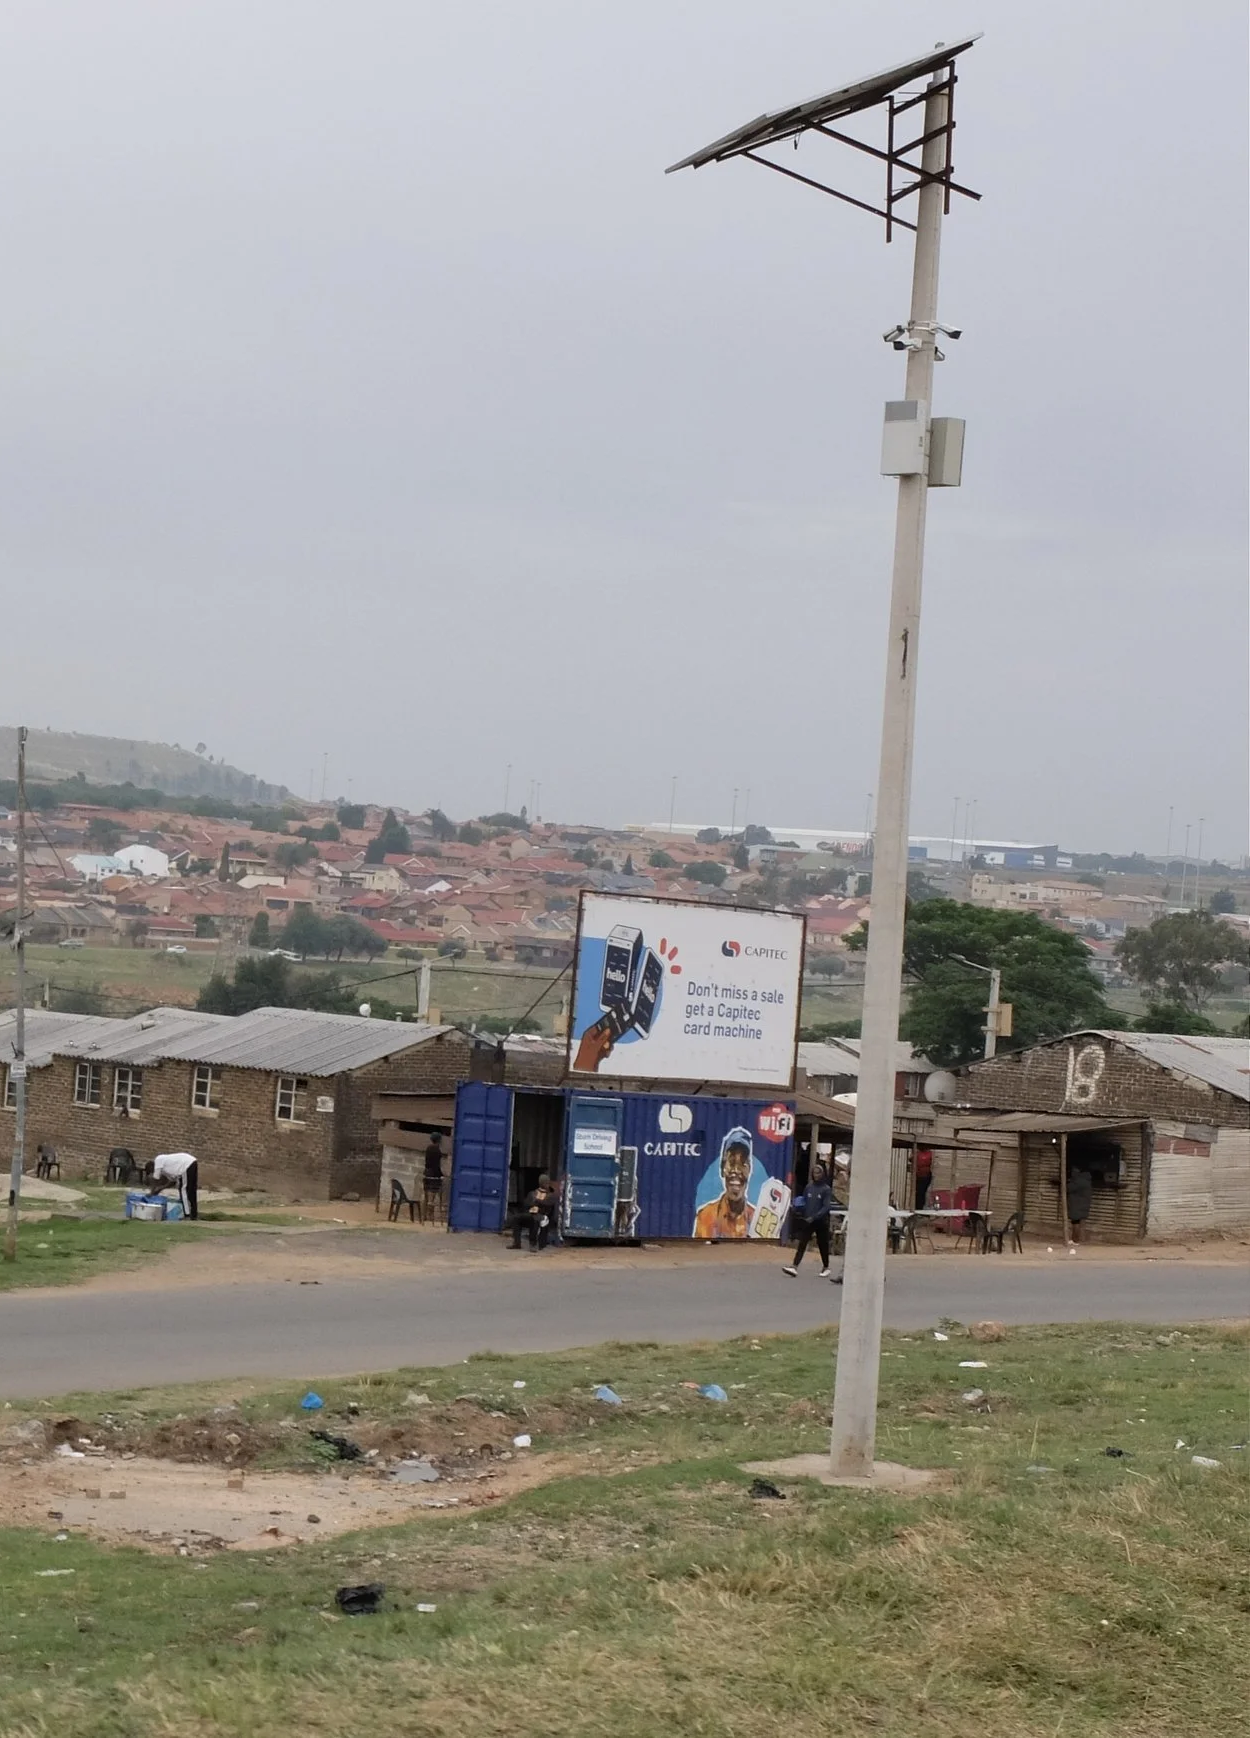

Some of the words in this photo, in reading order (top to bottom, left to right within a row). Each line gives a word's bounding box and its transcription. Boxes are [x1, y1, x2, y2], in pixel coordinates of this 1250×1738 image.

[744, 946, 788, 961] CAPITEC
[606, 967, 626, 983] hello
[687, 981, 719, 998] Don't
[721, 984, 749, 1001] miss
[751, 989, 758, 1001] a
[760, 989, 784, 1004] sale
[685, 1002, 705, 1019] get
[707, 1006, 715, 1017] a
[717, 1003, 761, 1021] Capitec
[683, 1021, 711, 1036] card
[713, 1023, 762, 1040] machine
[1065, 1044, 1106, 1104] 18
[643, 1141, 702, 1157] CAPITEC
